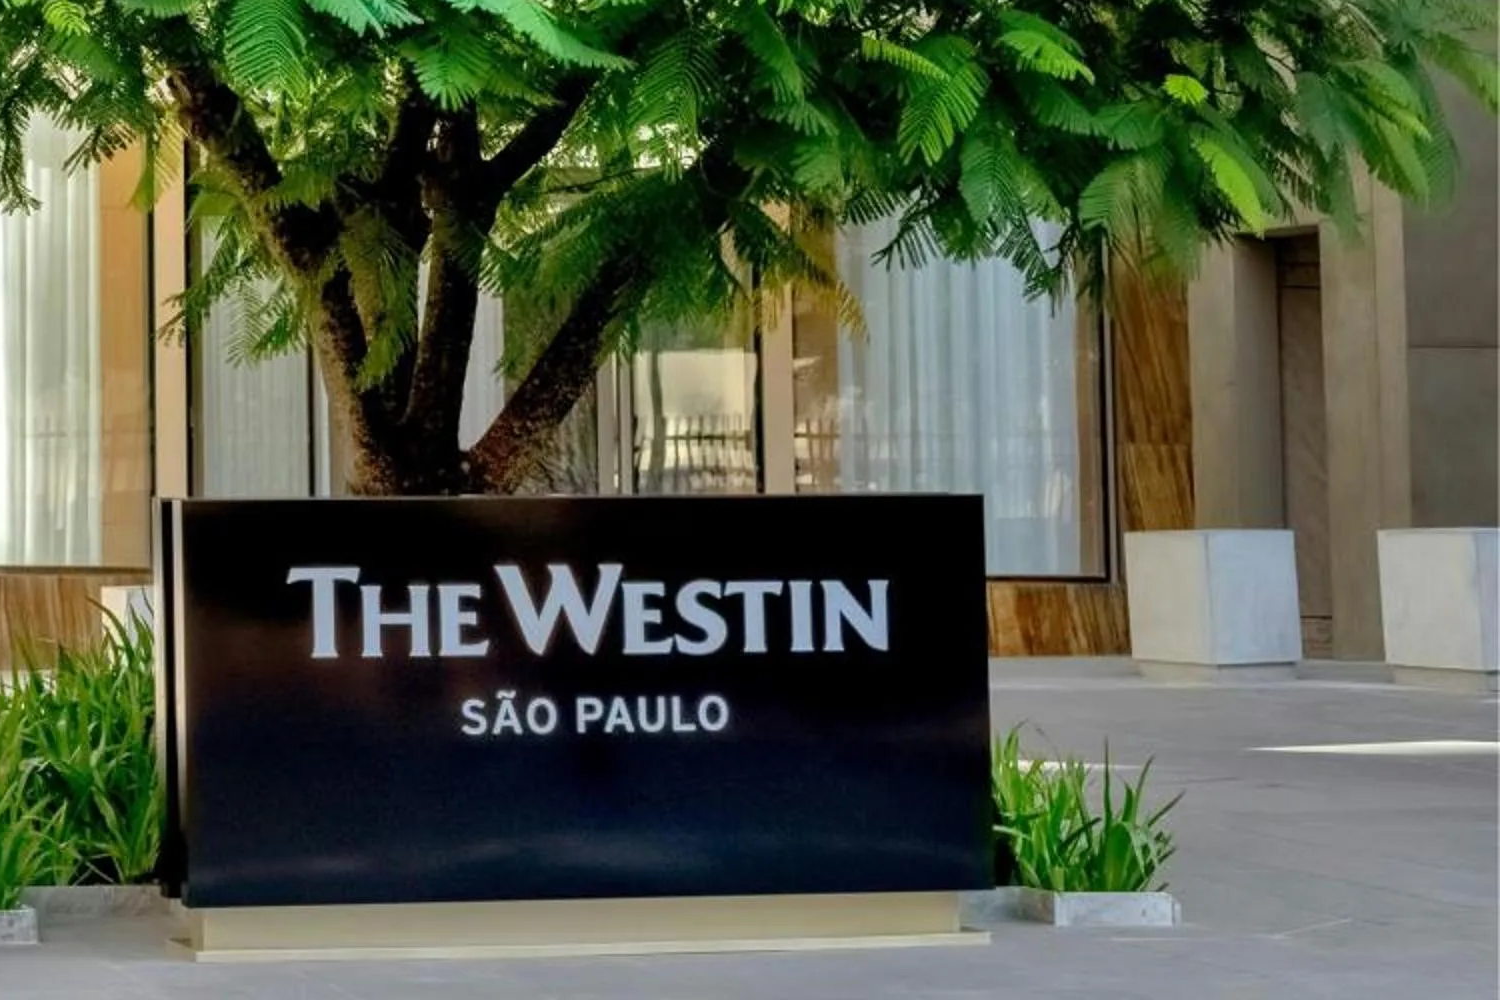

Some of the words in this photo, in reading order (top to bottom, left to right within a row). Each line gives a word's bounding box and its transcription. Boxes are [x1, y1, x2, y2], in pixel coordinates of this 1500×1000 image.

[285, 565, 490, 660] THE
[494, 562, 891, 656] WESTIN
[460, 689, 559, 737] SÃO
[575, 694, 730, 735] PAULO
